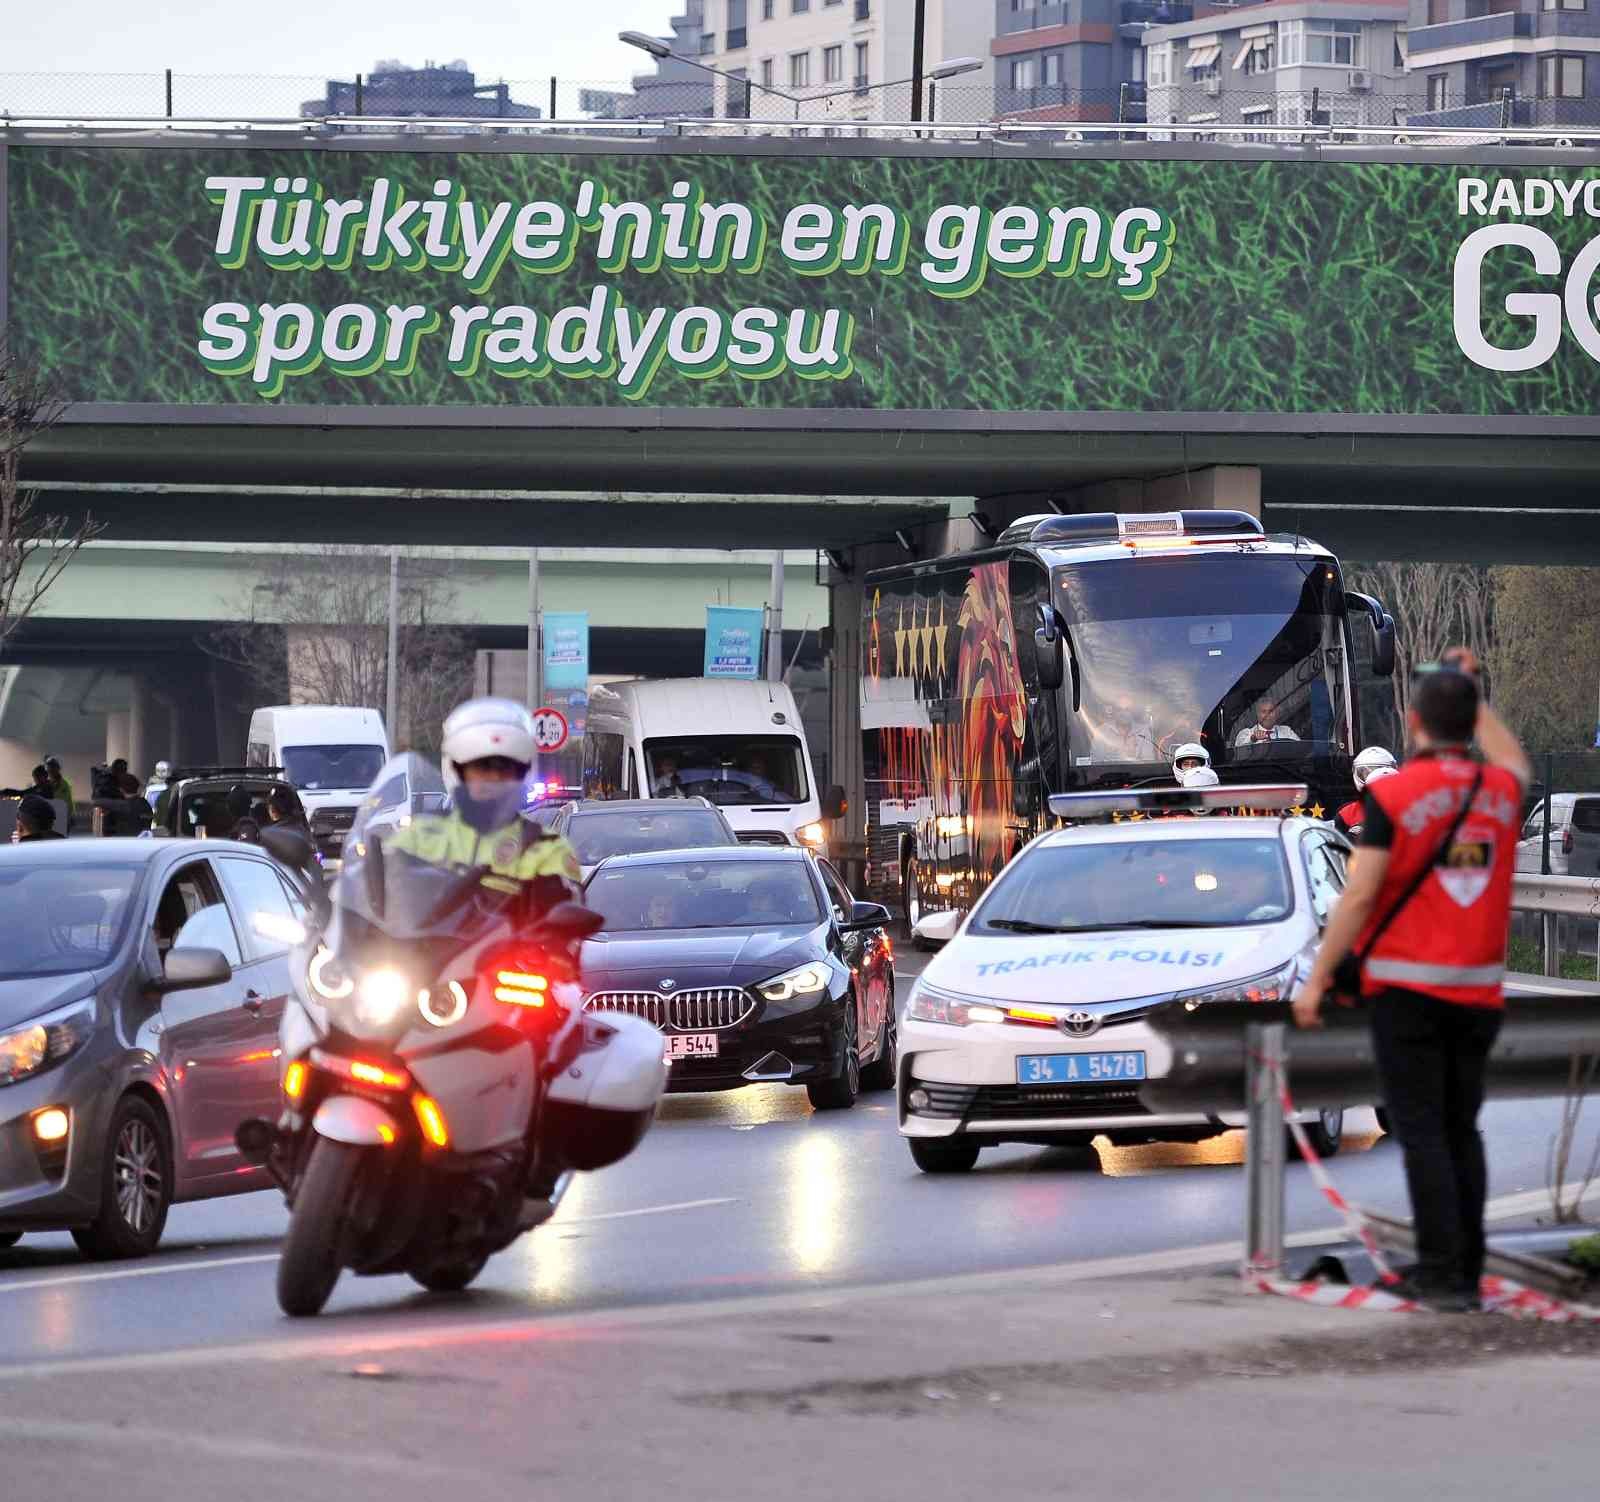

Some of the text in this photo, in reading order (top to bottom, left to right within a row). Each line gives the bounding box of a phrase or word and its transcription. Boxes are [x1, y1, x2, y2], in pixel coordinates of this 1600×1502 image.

[205, 176, 1163, 287] Türkiye'nin en genç
[198, 285, 839, 386] spor radyosu
[685, 1036, 712, 1053] 544
[1029, 1054, 1137, 1080] 34 A 5478
